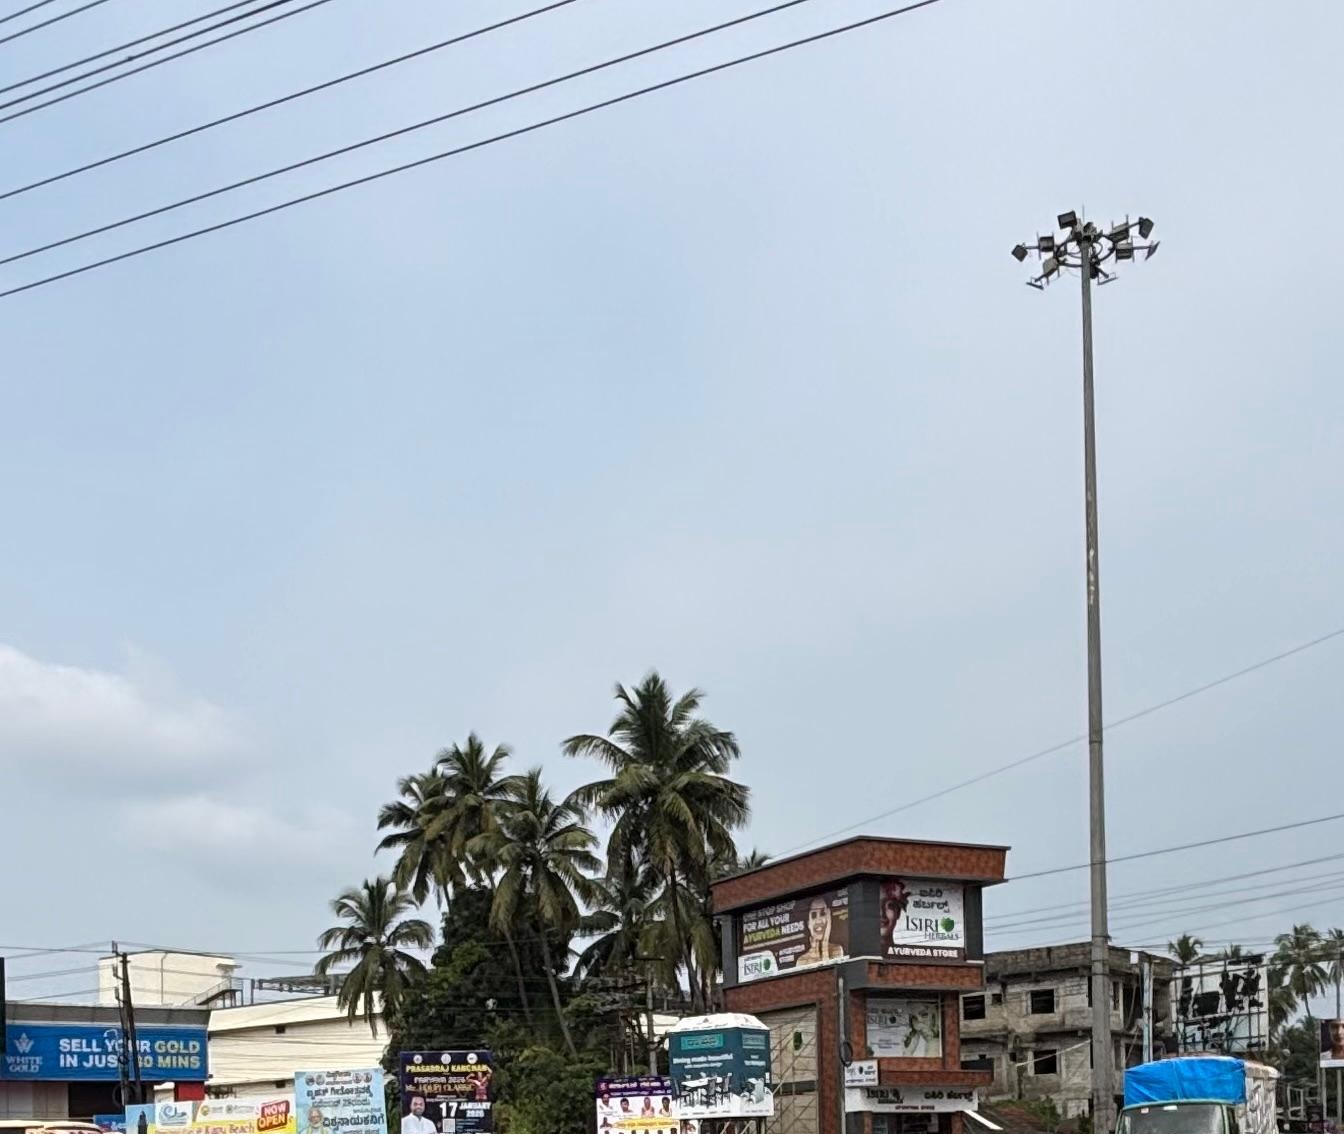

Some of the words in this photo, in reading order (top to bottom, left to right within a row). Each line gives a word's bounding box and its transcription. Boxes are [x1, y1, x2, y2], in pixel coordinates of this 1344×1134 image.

[743, 923, 757, 932] FOR
[757, 919, 769, 929] ALL
[769, 913, 790, 926] YOUR
[743, 928, 781, 944] AYURVEDA
[781, 921, 804, 935] NEEDS
[887, 946, 933, 957] AYURVEDA
[933, 949, 959, 958] STORE
[59, 1039, 102, 1053] SELL
[155, 1040, 201, 1054] GOLD
[7, 1056, 43, 1065] WHITE
[59, 1054, 78, 1068] IN
[157, 1055, 201, 1069] MINS
[9, 1064, 40, 1073] GOLD
[264, 1103, 286, 1117] NOW
[439, 1101, 458, 1117] 17
[229, 1121, 255, 1134] Beach
[257, 1115, 286, 1128] OPEN
